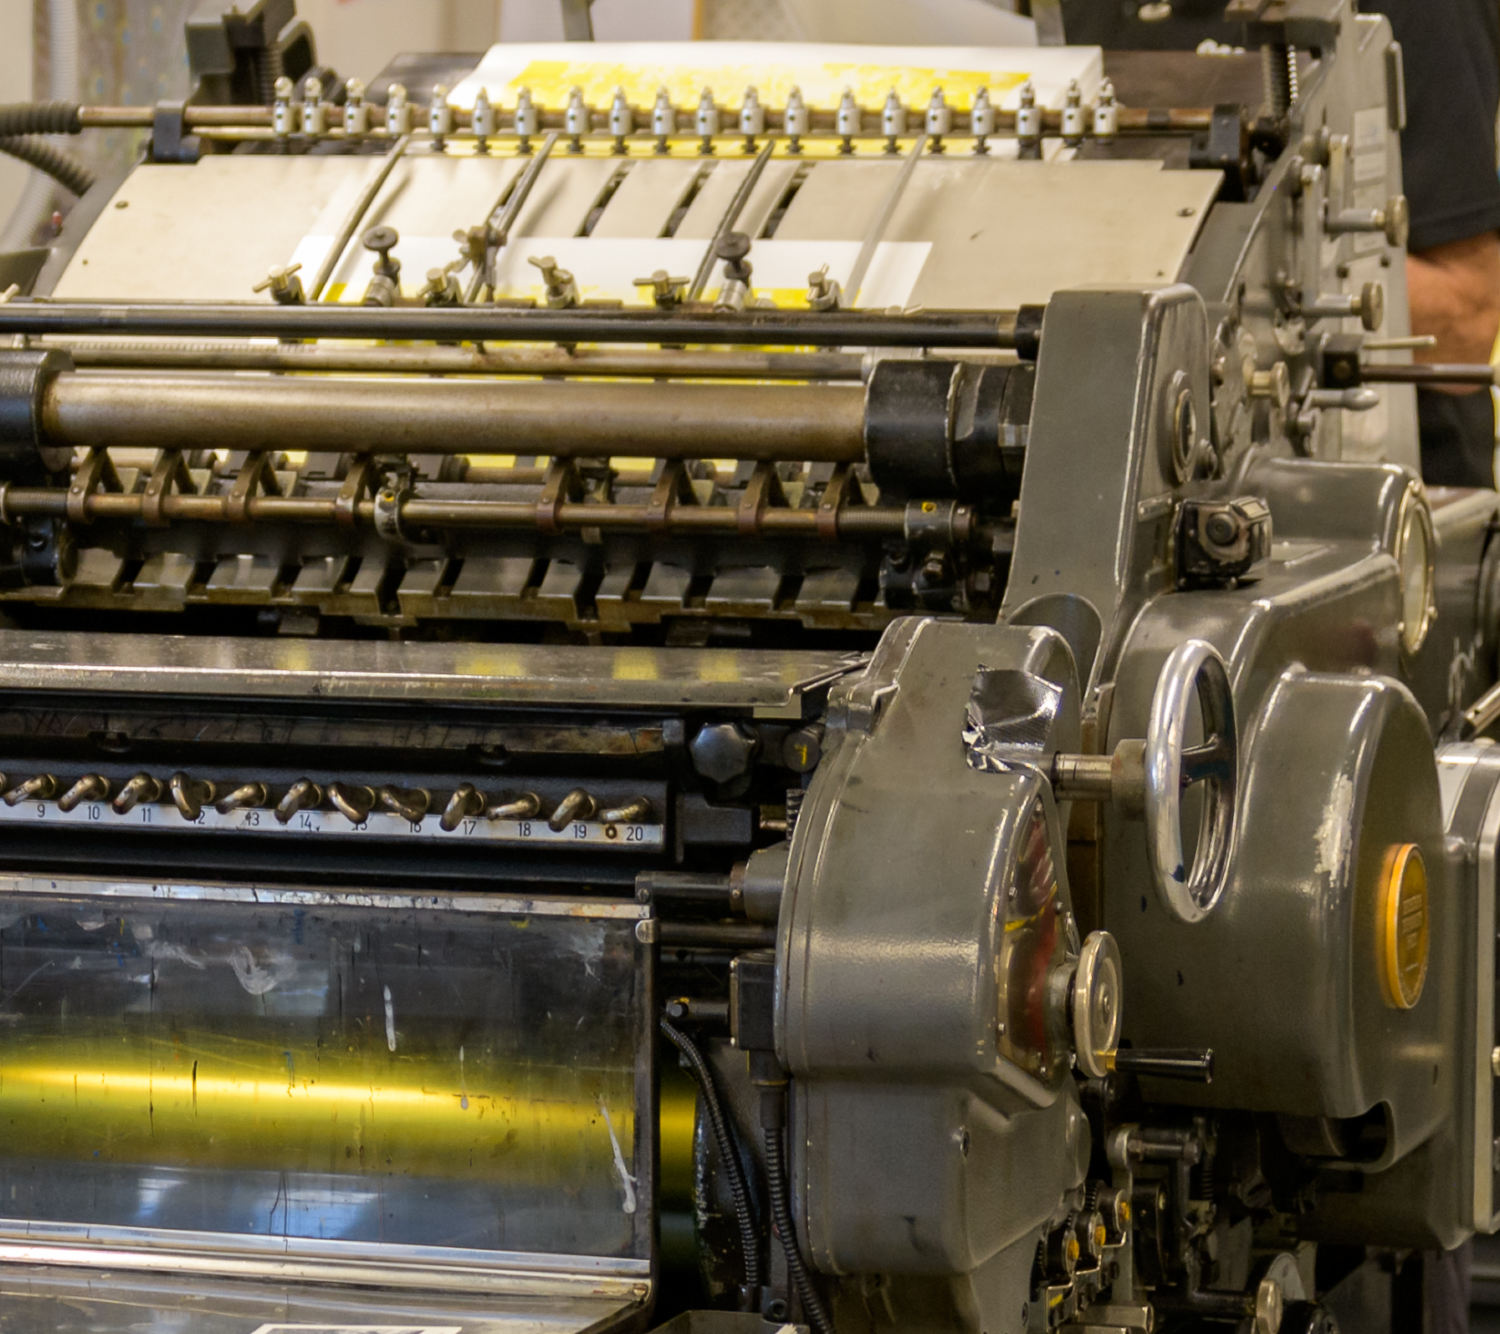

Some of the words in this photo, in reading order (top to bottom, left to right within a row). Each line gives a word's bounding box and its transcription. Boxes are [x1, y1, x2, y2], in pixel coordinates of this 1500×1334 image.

[37, 803, 45, 818] 9
[87, 805, 100, 820] 10
[142, 807, 151, 822] 11
[192, 810, 205, 825] 2
[299, 813, 312, 828] 14
[463, 820, 476, 836] 17
[518, 820, 531, 836] 18
[573, 823, 587, 839] 19
[626, 825, 643, 841] 20
